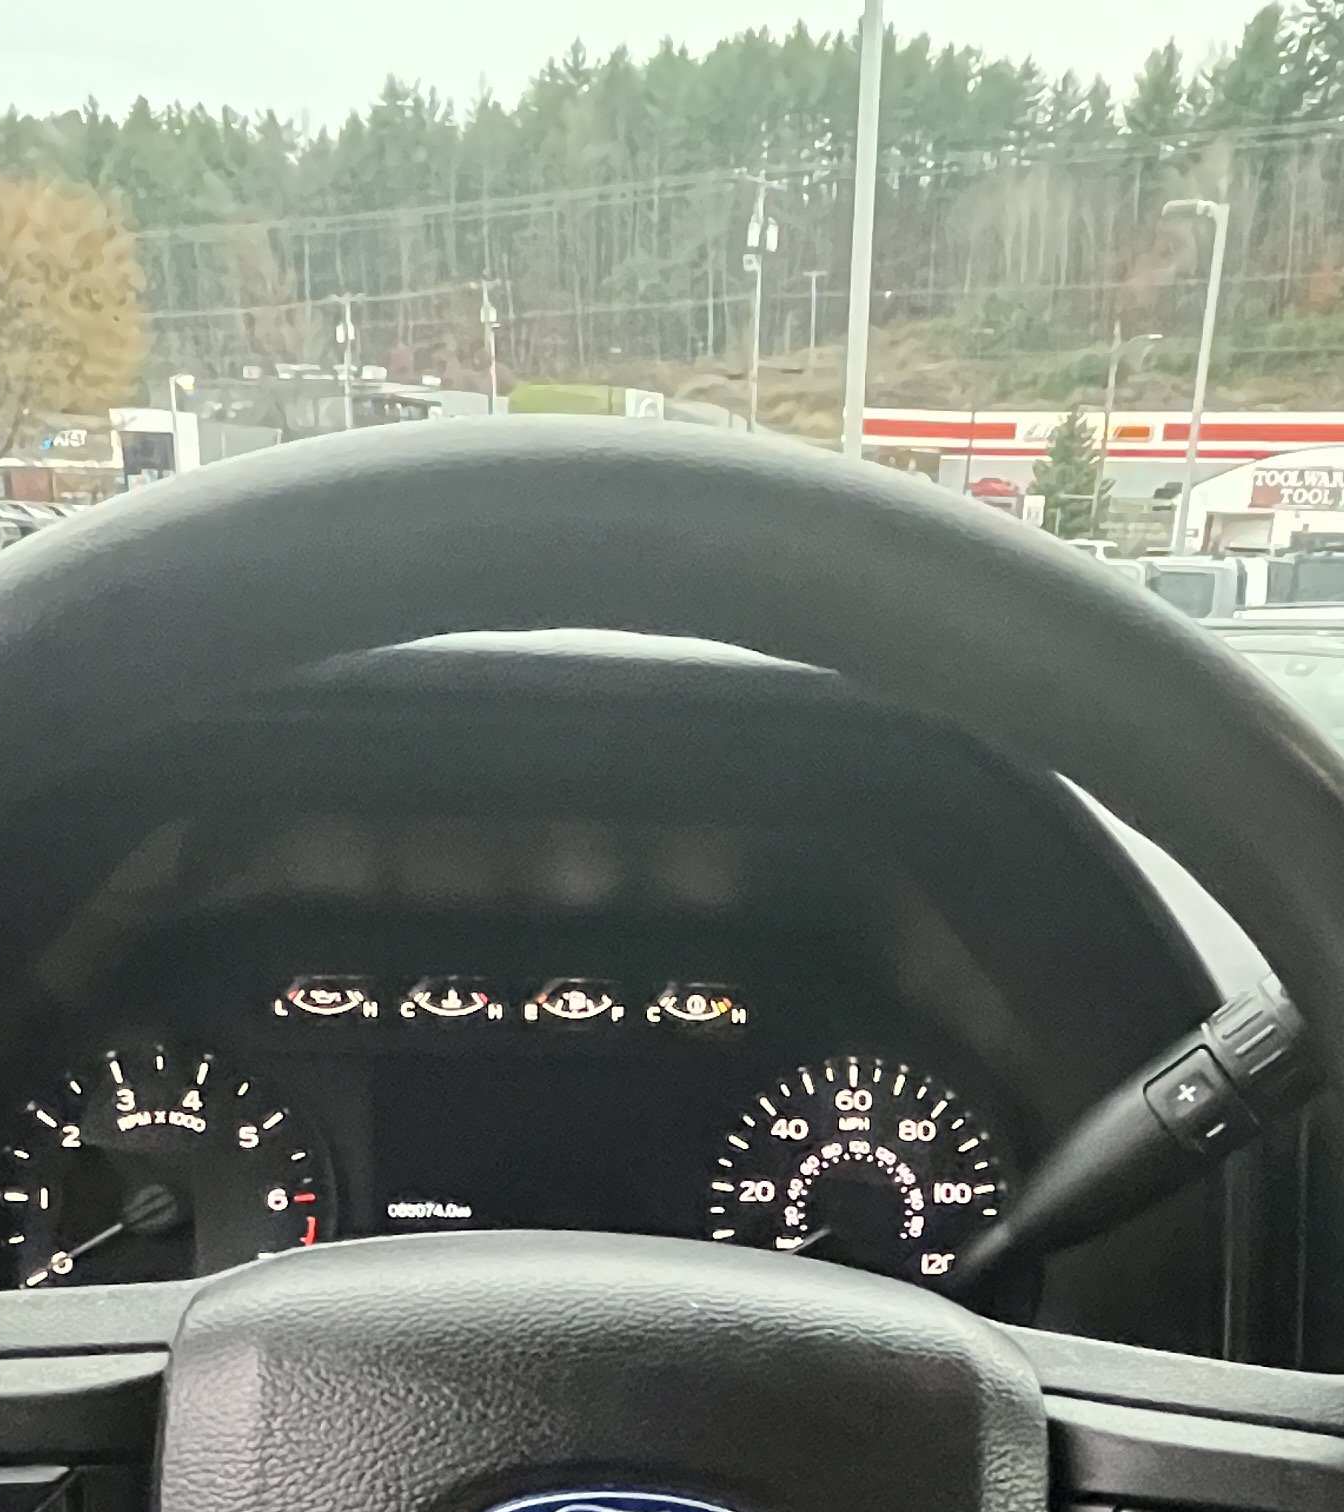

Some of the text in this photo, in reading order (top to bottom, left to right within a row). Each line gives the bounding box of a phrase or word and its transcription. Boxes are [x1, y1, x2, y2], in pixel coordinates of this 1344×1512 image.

[1280, 488, 1334, 505] TOOL
[116, 1089, 136, 1111] 3
[182, 1090, 202, 1111] 4
[835, 1089, 874, 1112] 60
[61, 1125, 81, 1148] 2
[238, 1126, 260, 1148] 5
[770, 1118, 809, 1140] 40
[898, 1119, 937, 1142] 80
[39, 1187, 49, 1210] 1
[267, 1188, 288, 1211] 6
[739, 1181, 775, 1202] 20
[933, 1182, 973, 1203] 100
